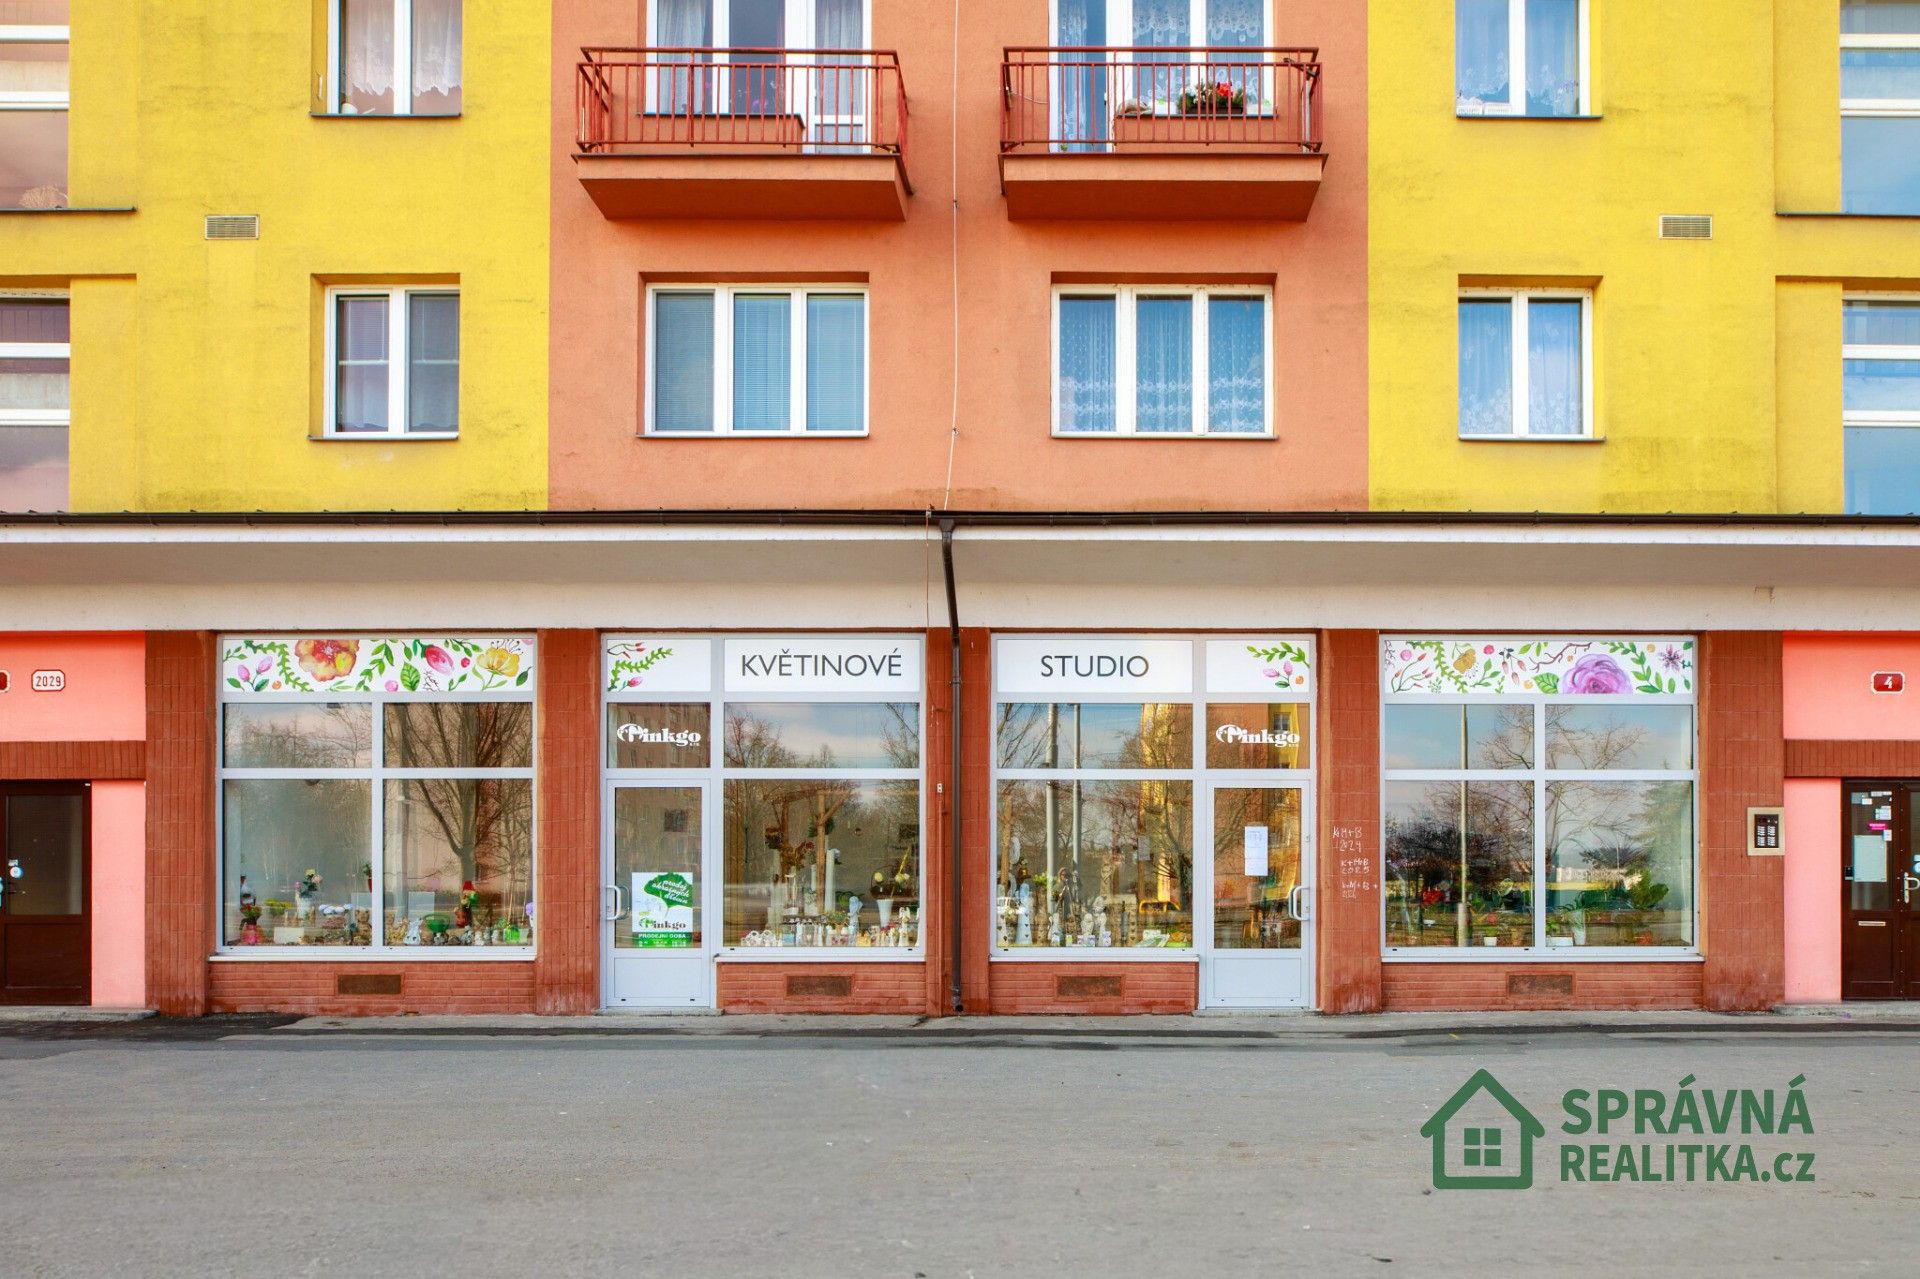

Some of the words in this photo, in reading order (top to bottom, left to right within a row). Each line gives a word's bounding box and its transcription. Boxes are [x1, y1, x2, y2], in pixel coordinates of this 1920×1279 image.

[742, 648, 902, 677] KVĚTINOVÉ
[1040, 655, 1150, 678] STUDIO
[36, 675, 61, 687] 2029
[1884, 676, 1893, 689] 4
